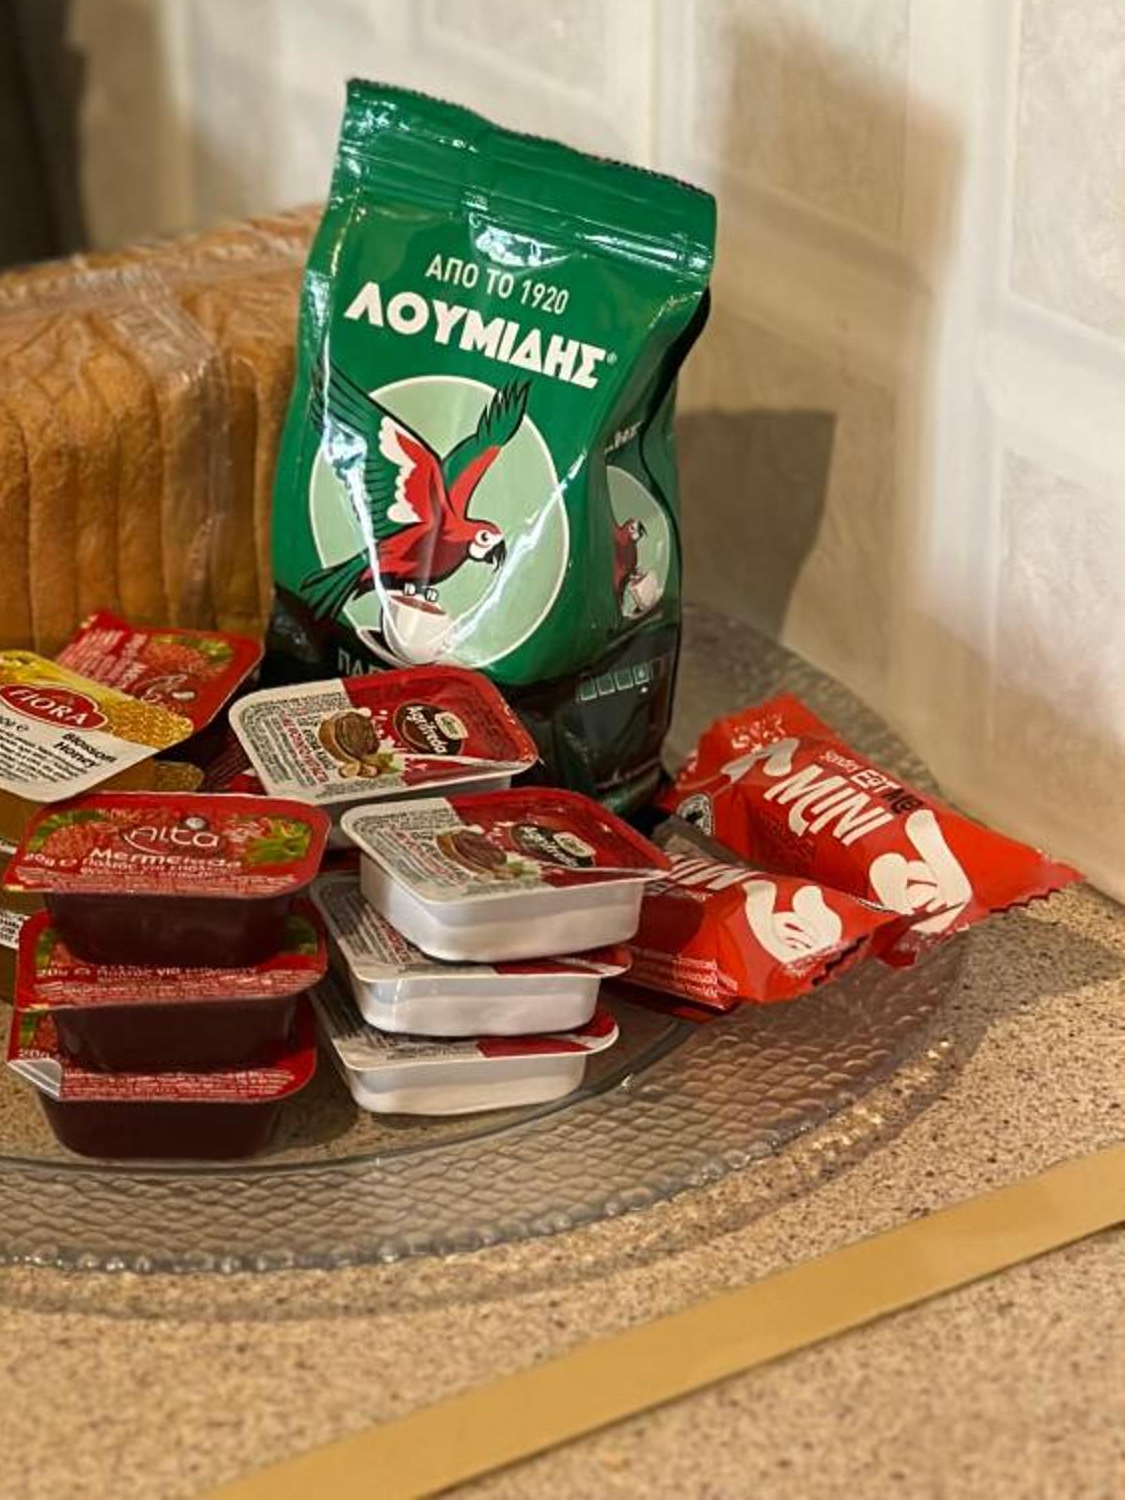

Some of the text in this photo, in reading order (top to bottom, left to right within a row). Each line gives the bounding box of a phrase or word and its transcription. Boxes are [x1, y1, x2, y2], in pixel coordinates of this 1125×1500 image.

[425, 253, 569, 316] ΑΠΟ ΤΟ 1920
[343, 280, 608, 390] ΛΟΥΜΙΔΗΣ
[7, 688, 89, 726] FIORA
[762, 763, 894, 847] MINI
